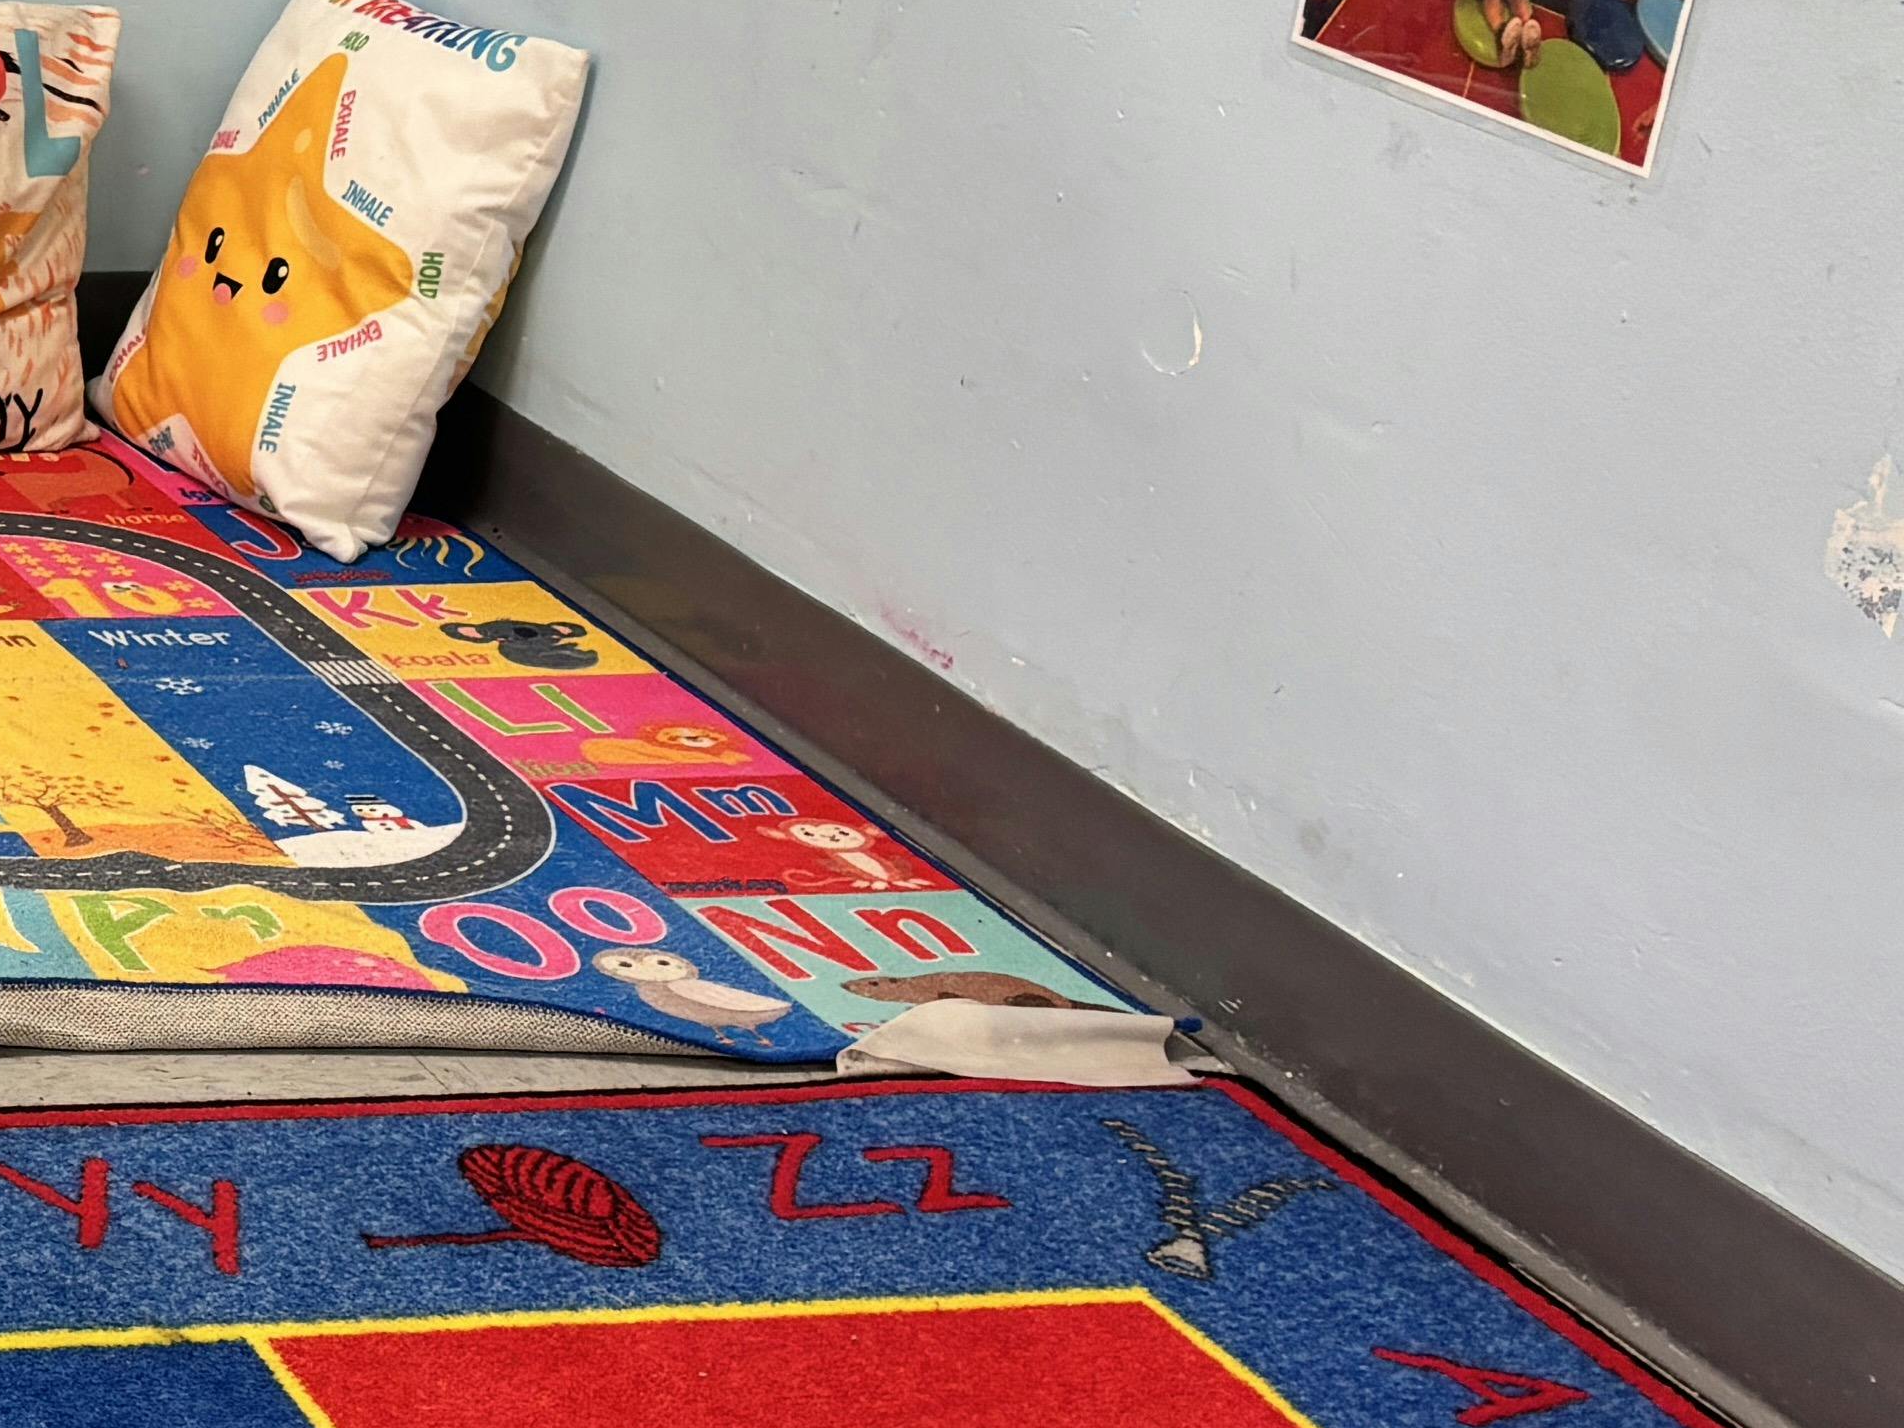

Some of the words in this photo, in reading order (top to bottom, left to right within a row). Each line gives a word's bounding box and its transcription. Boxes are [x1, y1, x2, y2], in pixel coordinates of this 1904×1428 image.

[330, 89, 356, 160] EXHALE
[342, 178, 393, 227] INHALE
[418, 252, 444, 300] HOLD
[259, 382, 296, 453] INHALE
[89, 628, 233, 650] Winter
[391, 650, 493, 670] koala
[700, 1131, 1010, 1220] Zz
